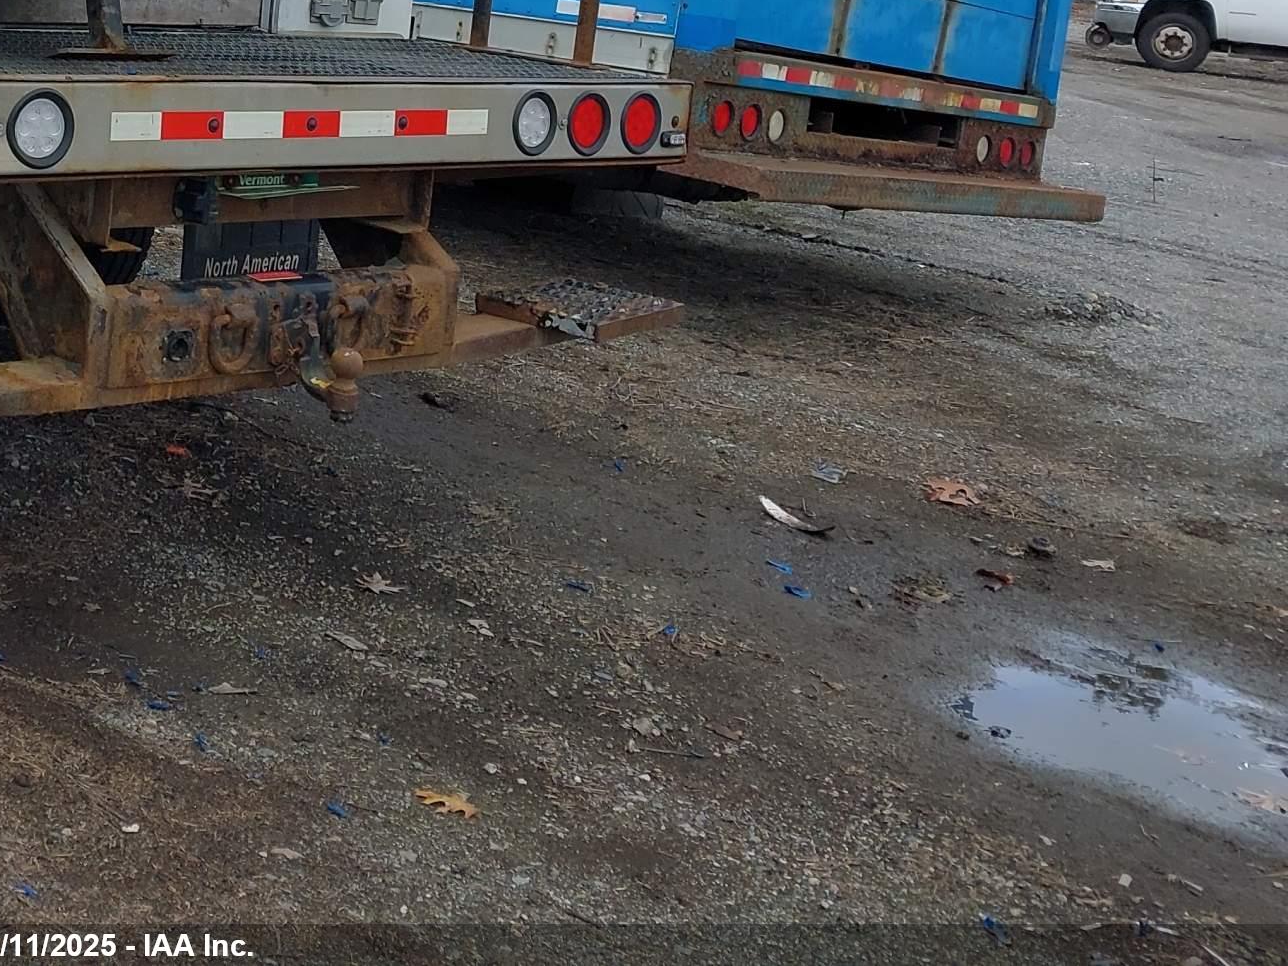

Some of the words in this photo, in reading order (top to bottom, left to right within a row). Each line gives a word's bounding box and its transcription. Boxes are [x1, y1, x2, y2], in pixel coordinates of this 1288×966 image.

[239, 174, 285, 186] Vermont
[204, 255, 238, 278] North
[241, 251, 299, 274] American
